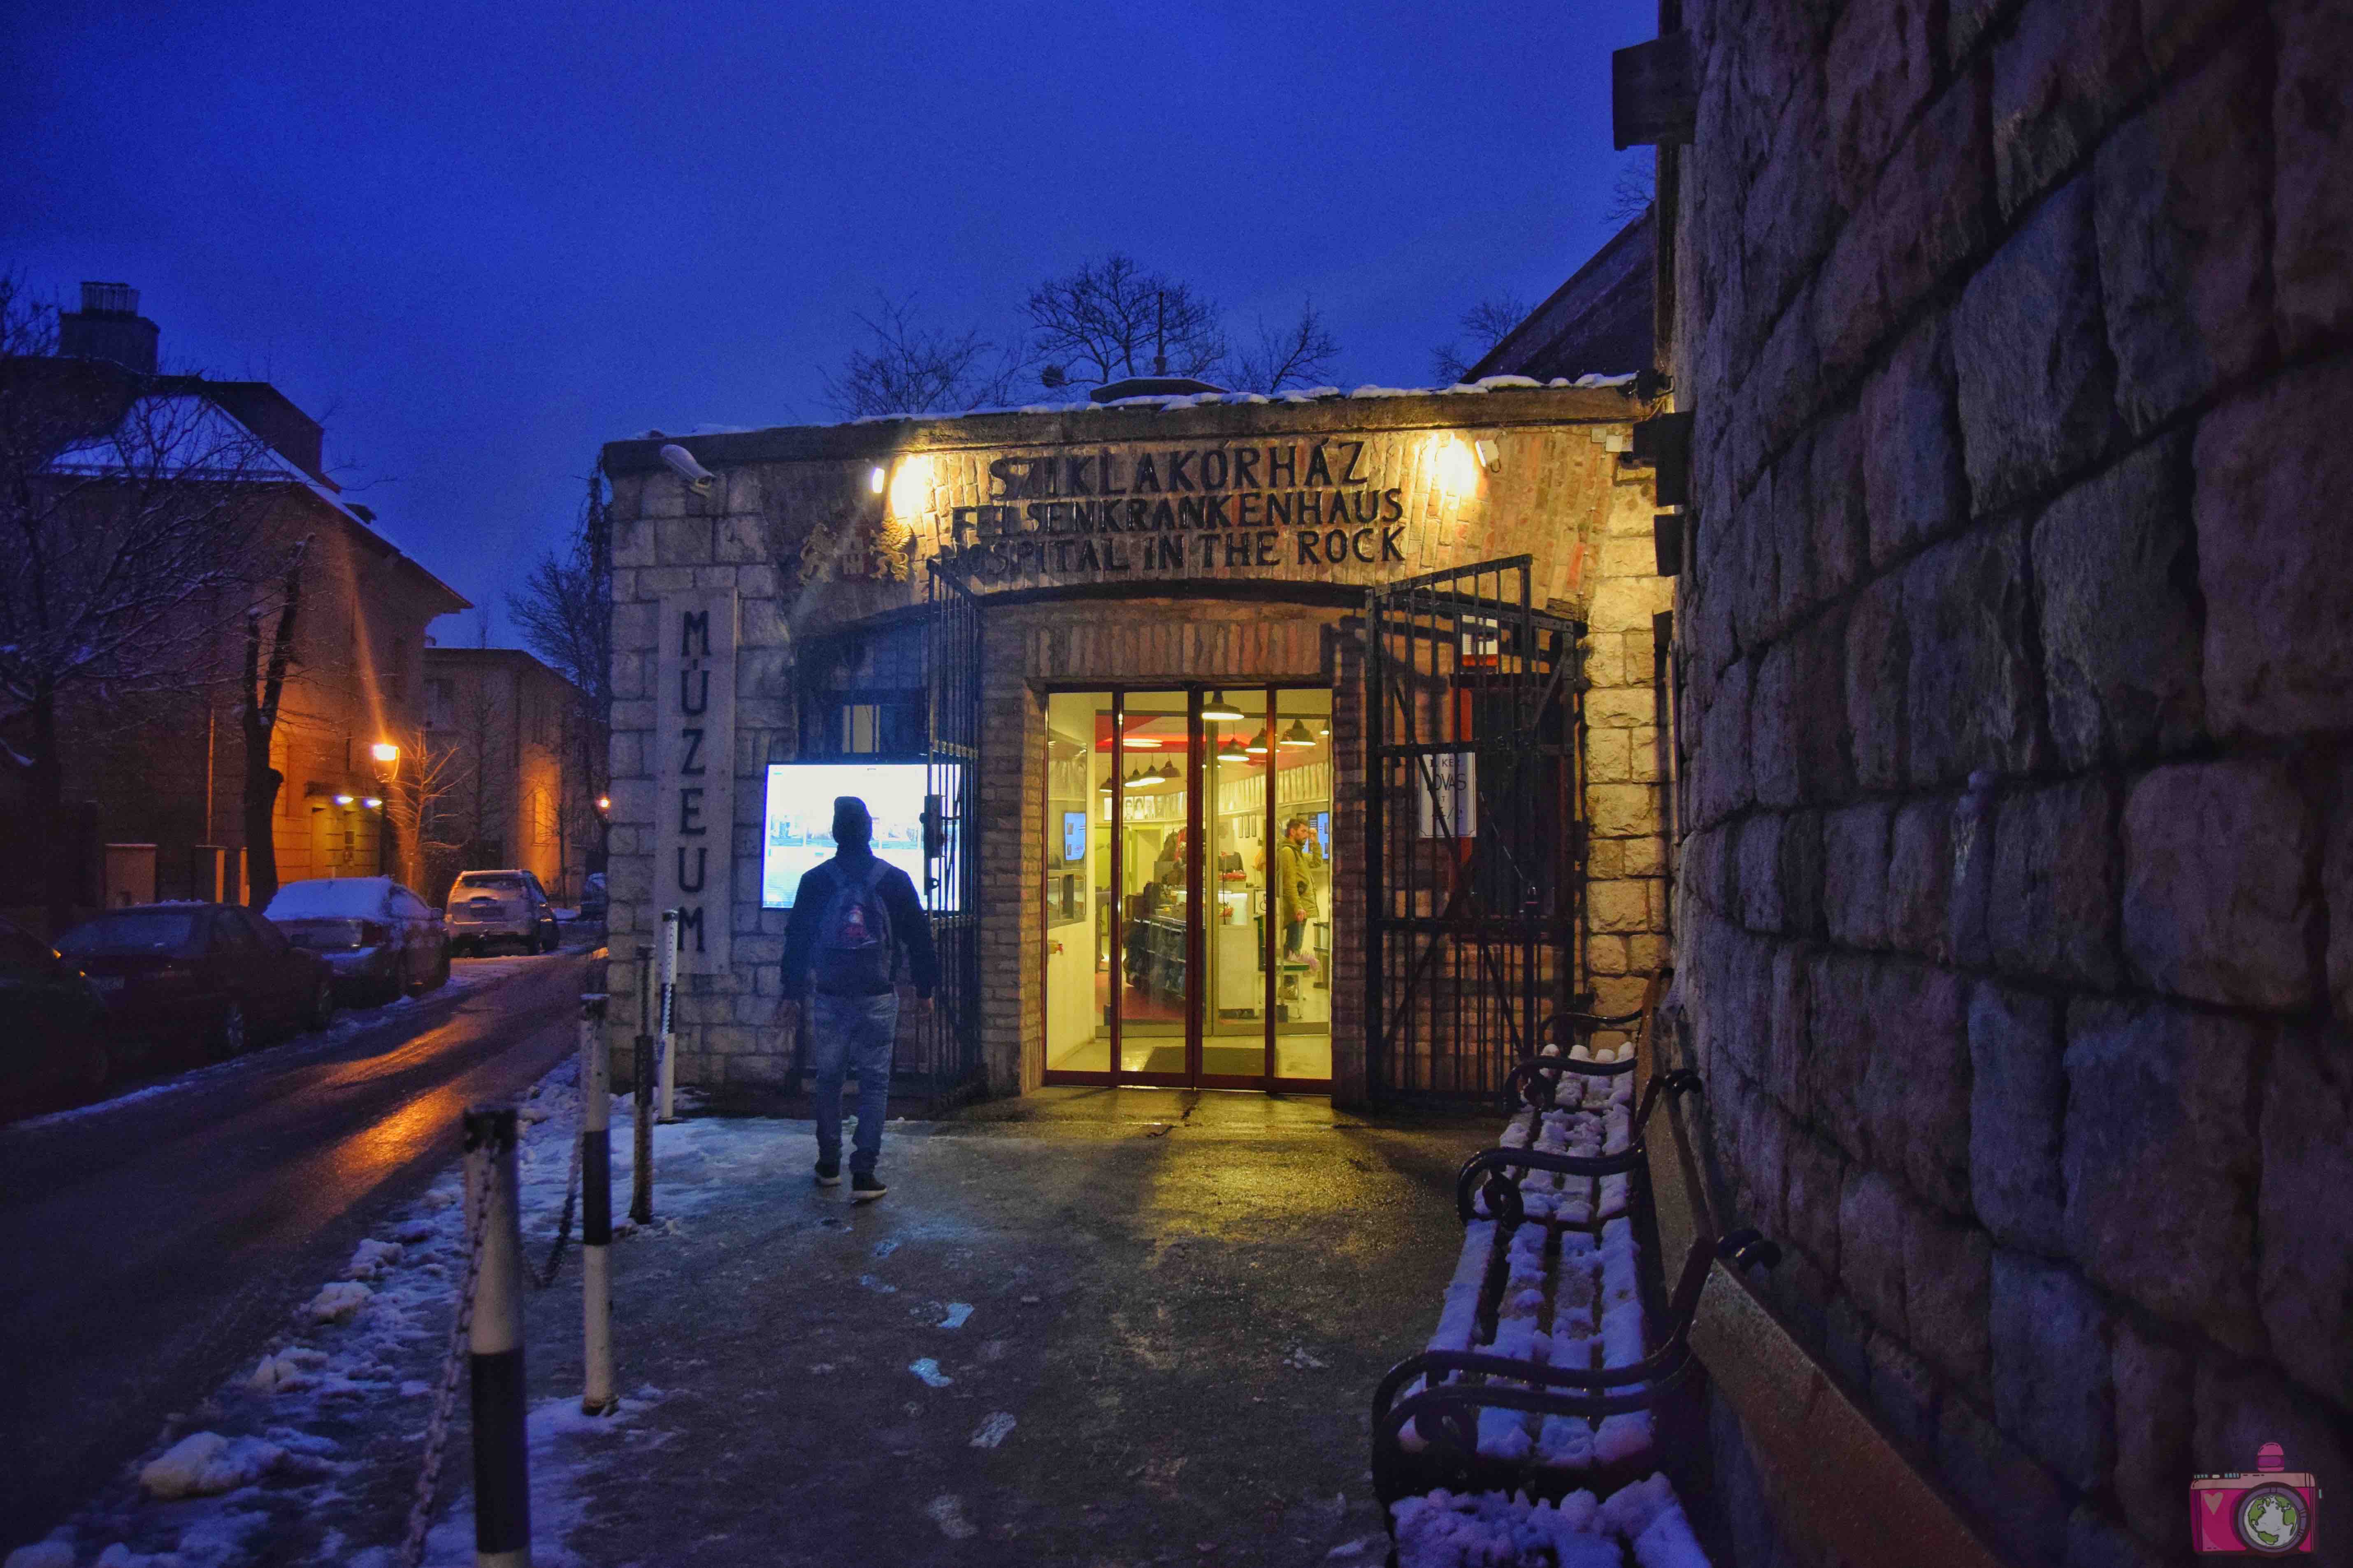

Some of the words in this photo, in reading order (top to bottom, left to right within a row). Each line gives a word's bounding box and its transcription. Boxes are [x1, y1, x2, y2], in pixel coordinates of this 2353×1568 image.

[989, 438, 1368, 499] SZIKLAKÓRHÁZ
[951, 488, 1403, 540] FELSENKRANKENHAUS
[1143, 536, 1184, 570] IN
[1198, 532, 1280, 568] THE
[1297, 527, 1406, 565] ROCK
[676, 610, 711, 952] MÚZEUM
[1428, 773, 1467, 791] OVAS
